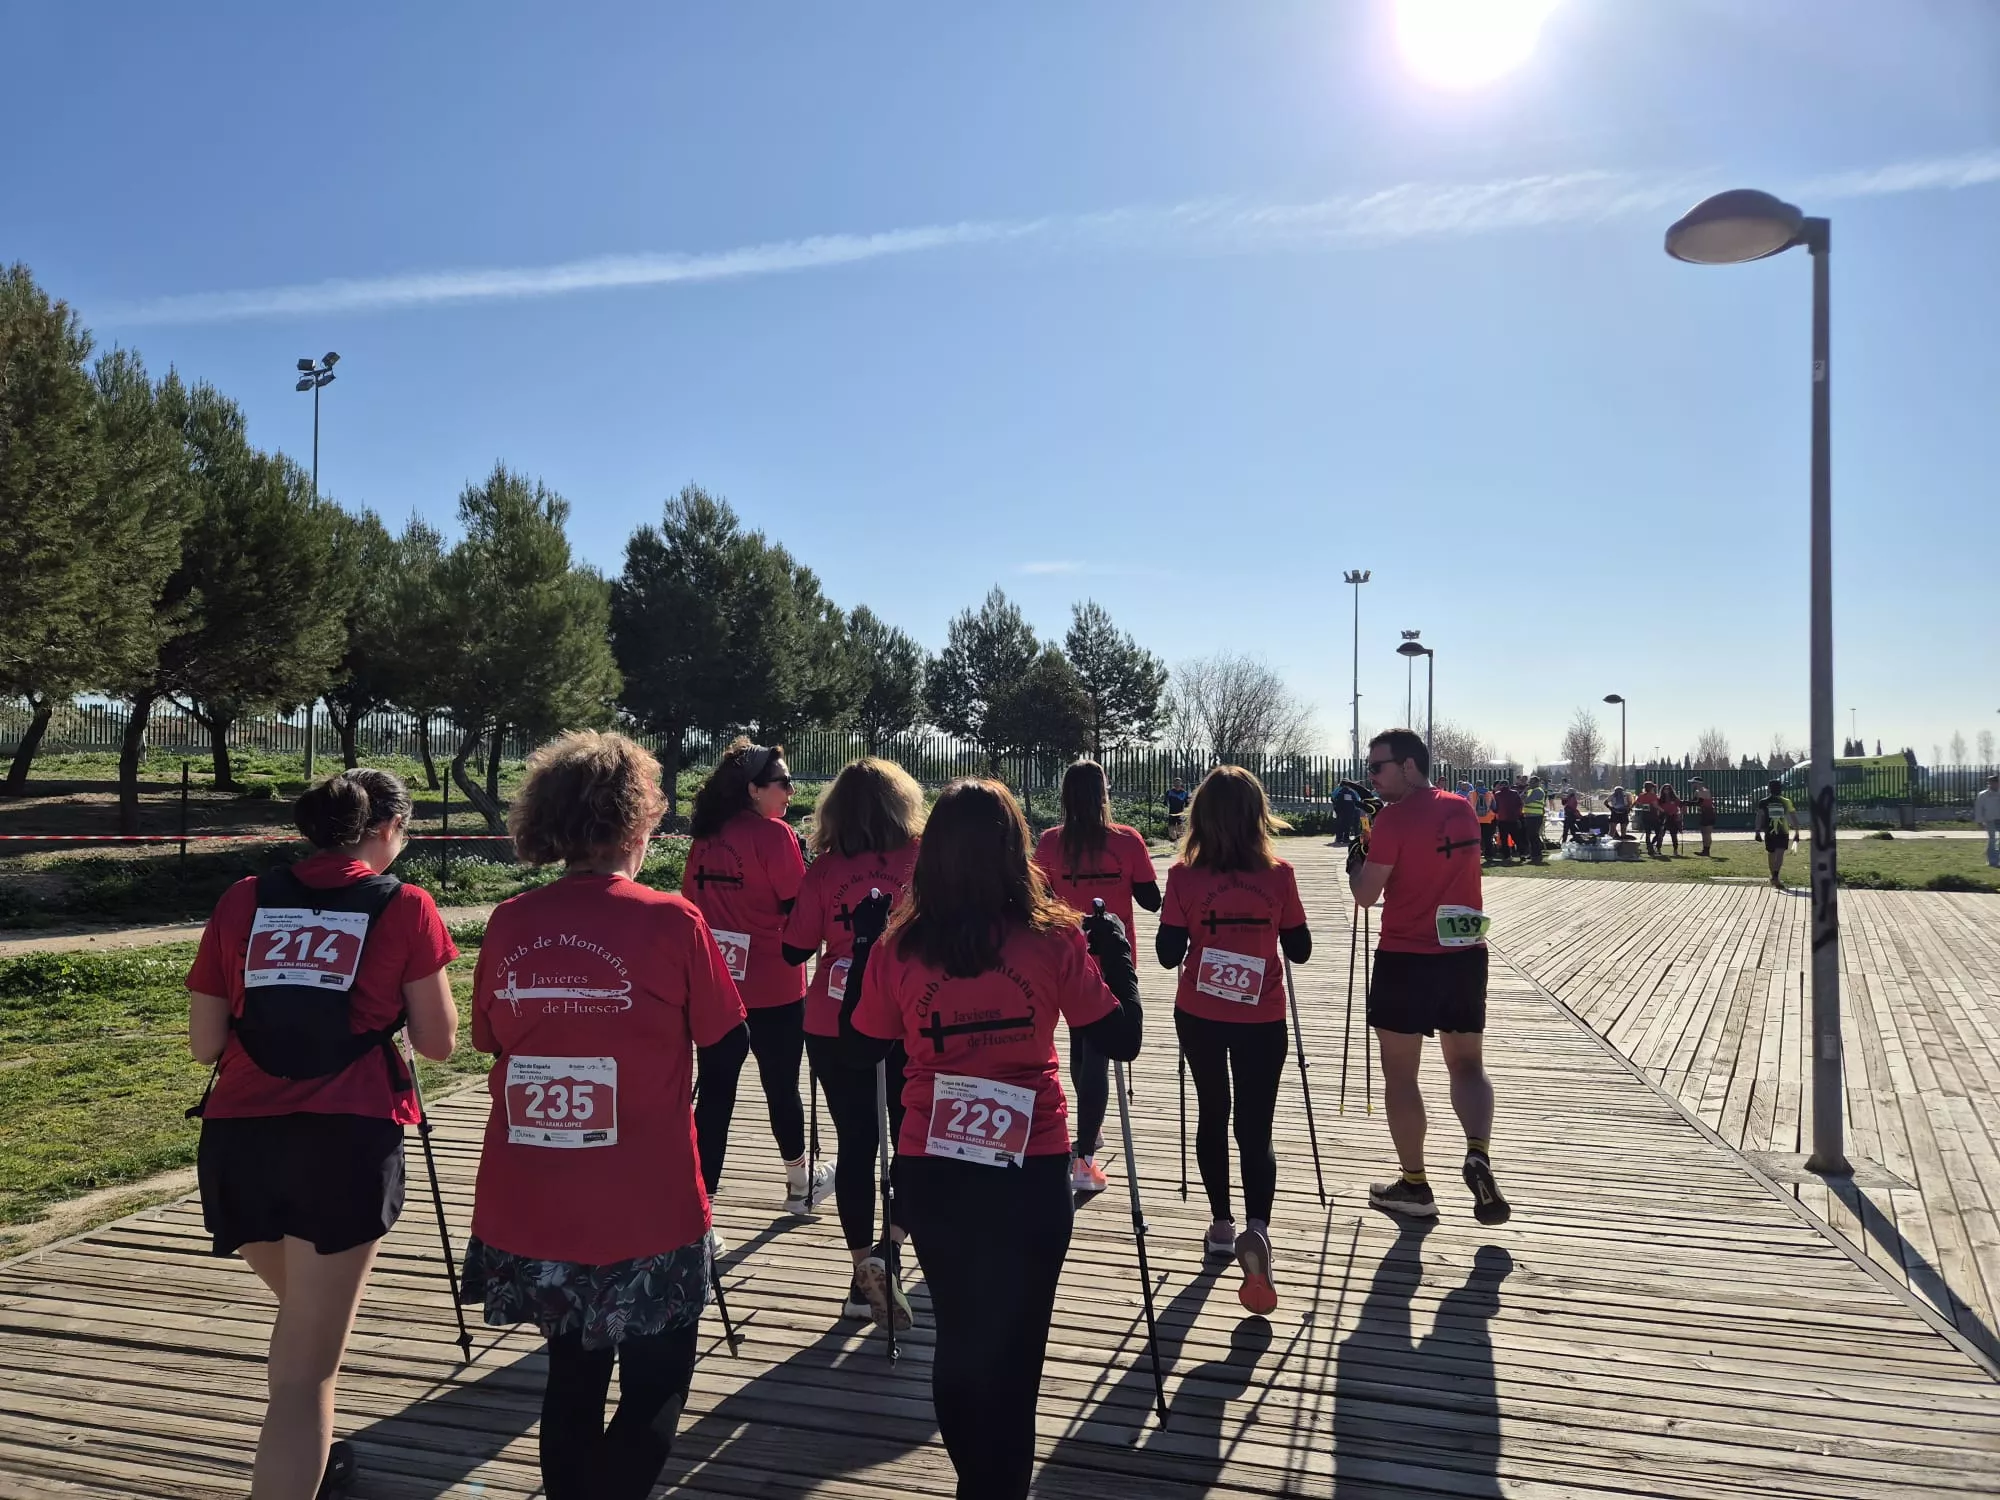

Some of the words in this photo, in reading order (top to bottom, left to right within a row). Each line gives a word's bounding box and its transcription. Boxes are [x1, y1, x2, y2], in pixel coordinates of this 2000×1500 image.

[1447, 917, 1481, 933] 139
[264, 931, 340, 963] 214
[496, 945, 528, 978] Club
[533, 936, 552, 949] de
[559, 934, 628, 977] Montaña
[530, 973, 588, 988] Javieres
[1210, 963, 1251, 989] 236
[542, 1002, 559, 1013] de
[564, 1001, 619, 1014] Huesca
[916, 982, 939, 1018] Club
[953, 1007, 1002, 1023] Javieres
[967, 1035, 980, 1048] de
[983, 1031, 1028, 1046] Huesca
[525, 1084, 594, 1120] 235
[947, 1100, 1012, 1140] 229
